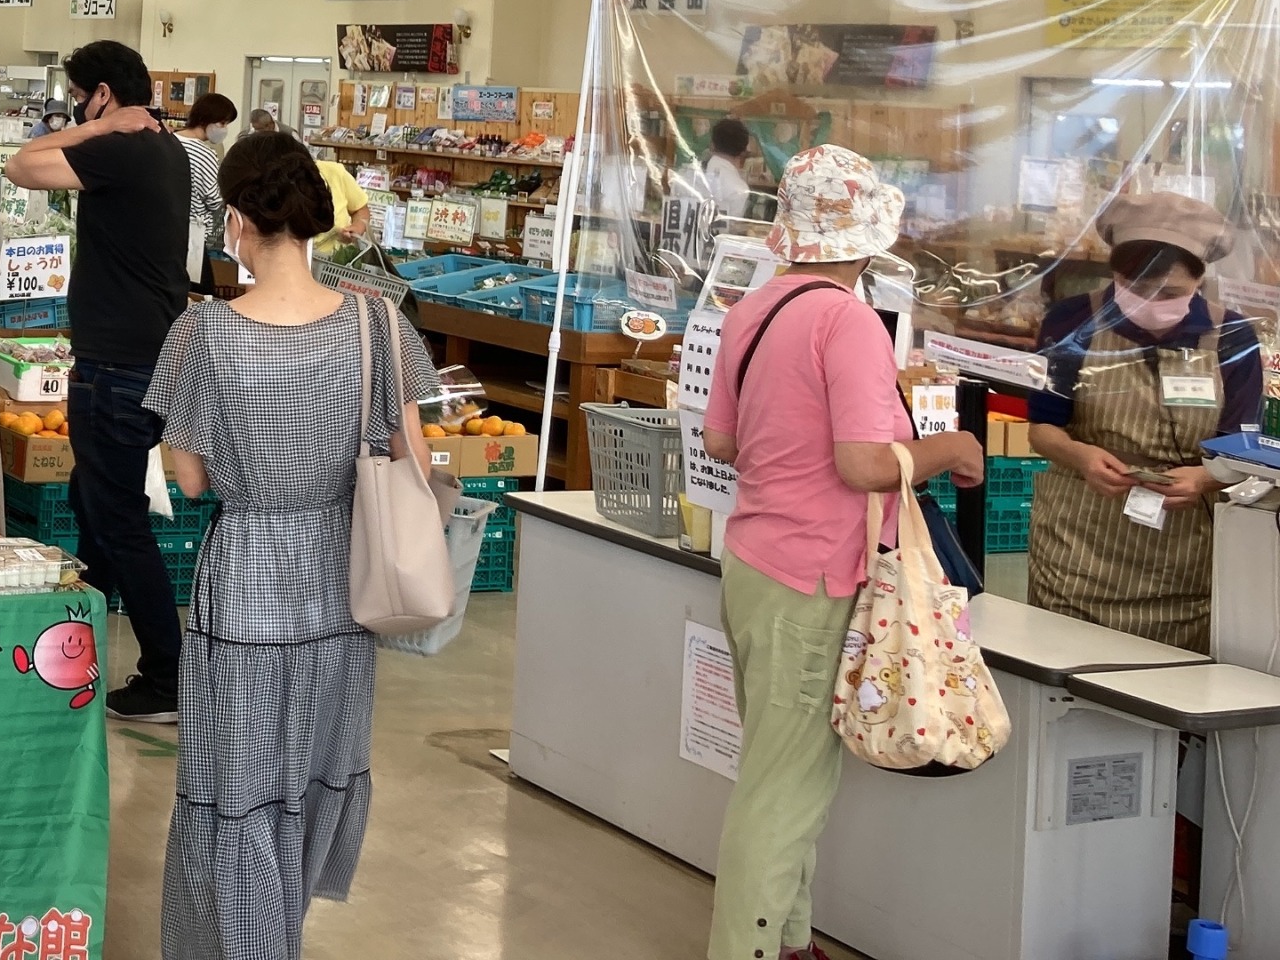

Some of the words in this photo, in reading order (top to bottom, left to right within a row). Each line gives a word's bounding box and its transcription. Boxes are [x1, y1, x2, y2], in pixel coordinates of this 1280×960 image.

[6, 243, 64, 257] 本日のお買得
[8, 255, 62, 272] しょうが
[7, 276, 37, 291] ¥100
[43, 380, 59, 393] 40
[920, 421, 946, 432] ¥100
